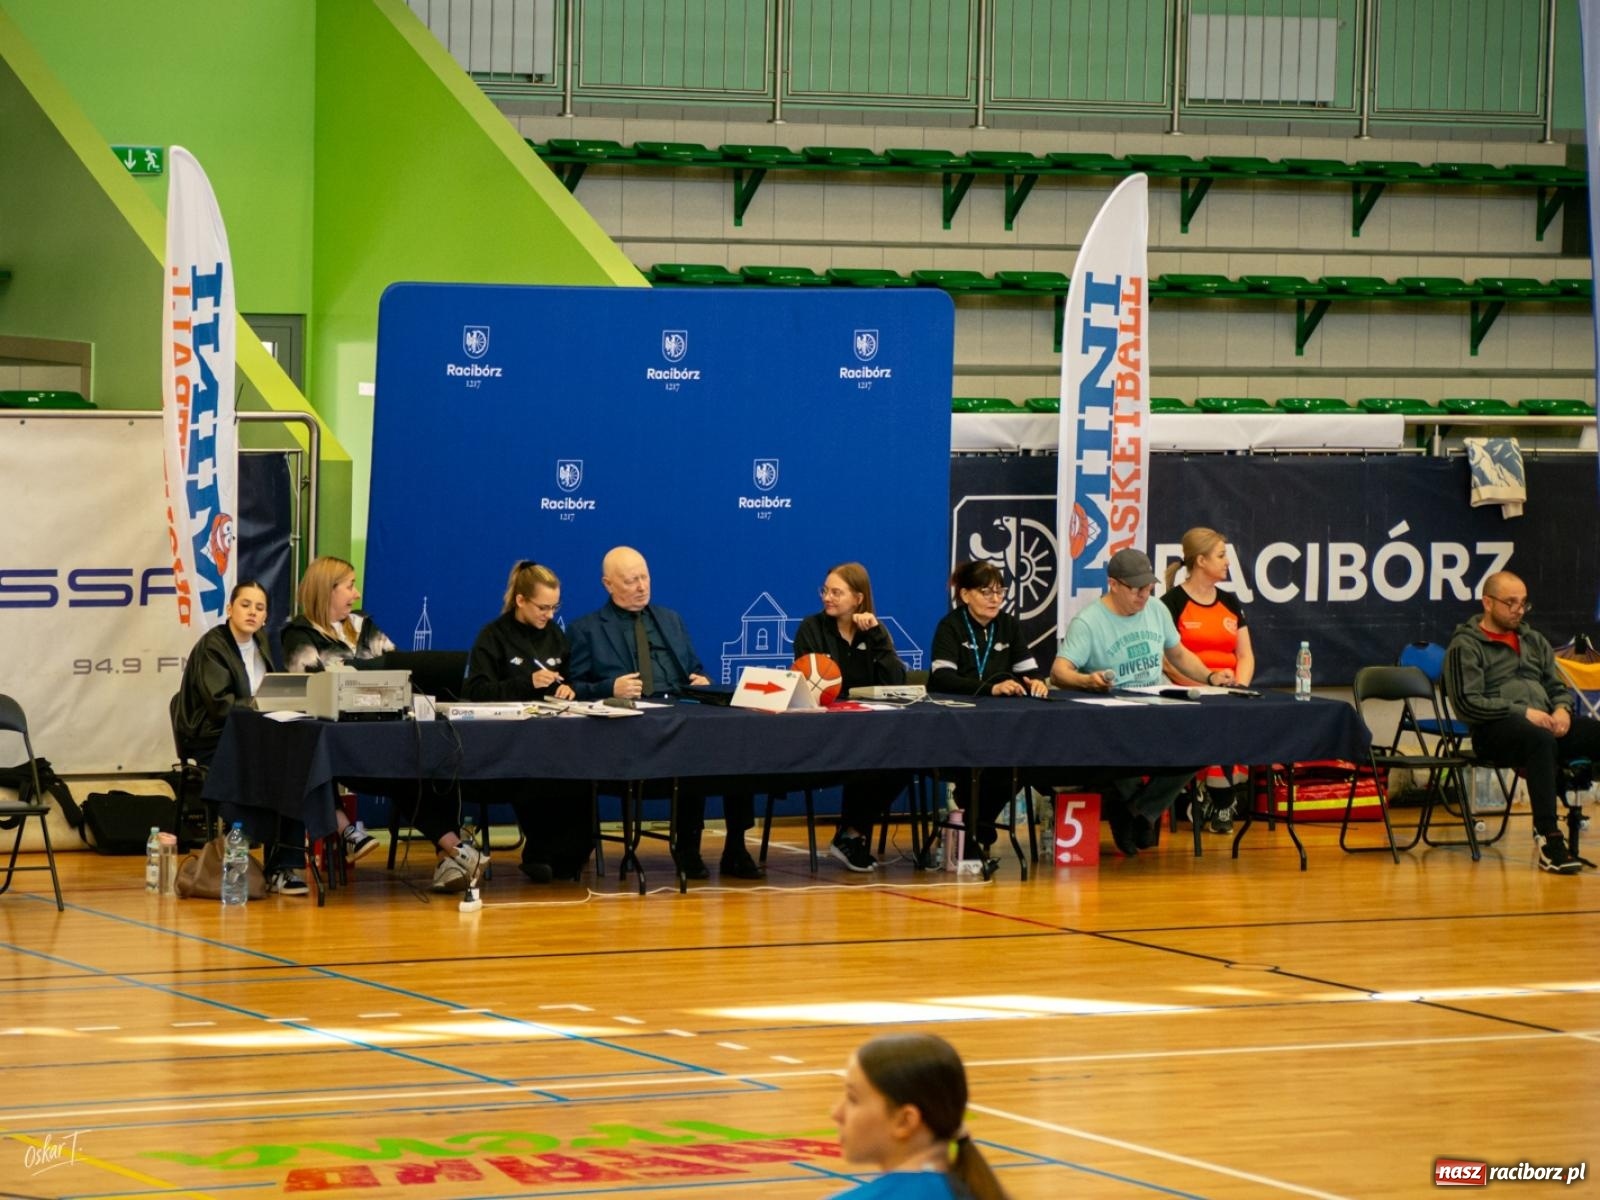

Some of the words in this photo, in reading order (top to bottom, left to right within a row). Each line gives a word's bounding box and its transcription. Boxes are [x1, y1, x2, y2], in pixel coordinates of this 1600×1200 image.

[447, 364, 502, 377] Racibórz
[647, 368, 700, 380] Racibórz
[840, 366, 892, 379] Racibórz
[1109, 277, 1142, 556] ASKETBALL
[1071, 272, 1121, 597] MINI
[541, 497, 596, 510] Racibórz
[739, 496, 791, 509] Racibórz
[73, 658, 142, 675] 94.9
[1119, 653, 1160, 677] DIVERSE
[1056, 801, 1086, 848] 5
